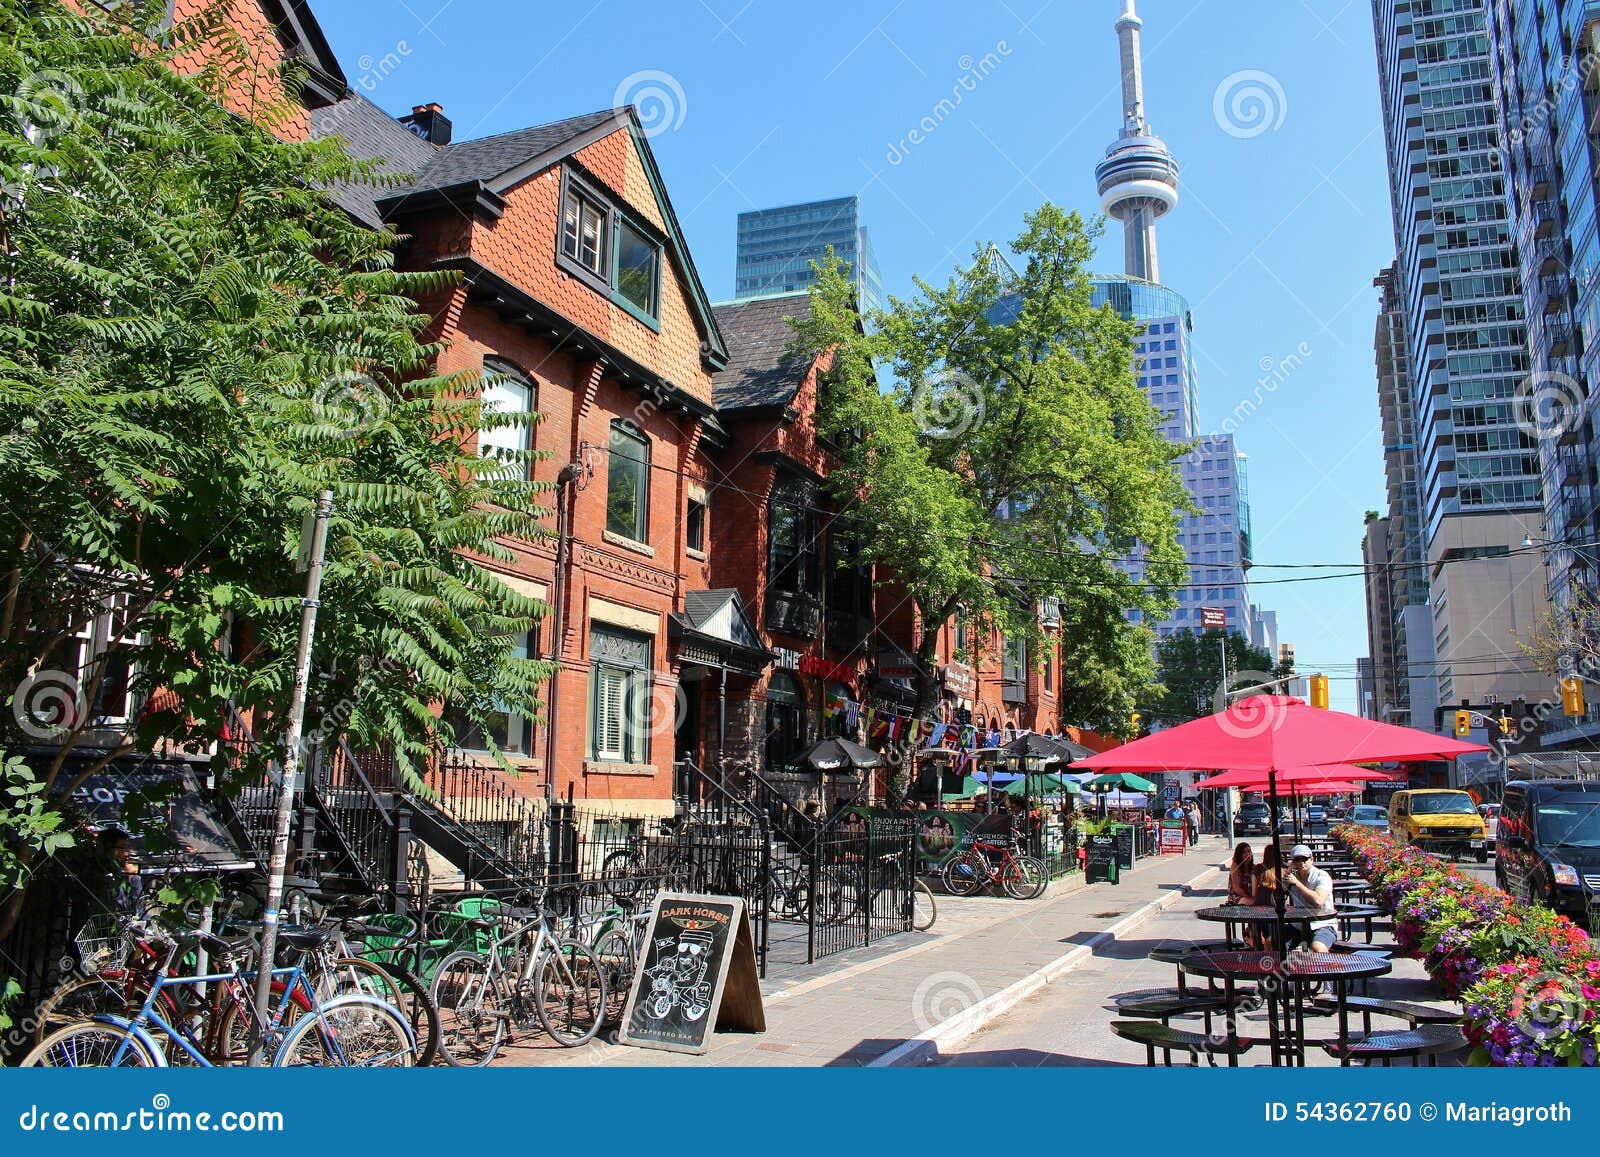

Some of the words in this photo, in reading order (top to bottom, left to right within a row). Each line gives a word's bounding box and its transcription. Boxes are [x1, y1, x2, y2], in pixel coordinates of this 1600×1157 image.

[780, 647, 800, 670] THE
[873, 817, 892, 825] ENJOY
[893, 817, 899, 825] A
[661, 907, 691, 919] DARK
[692, 907, 731, 925] HORSE
